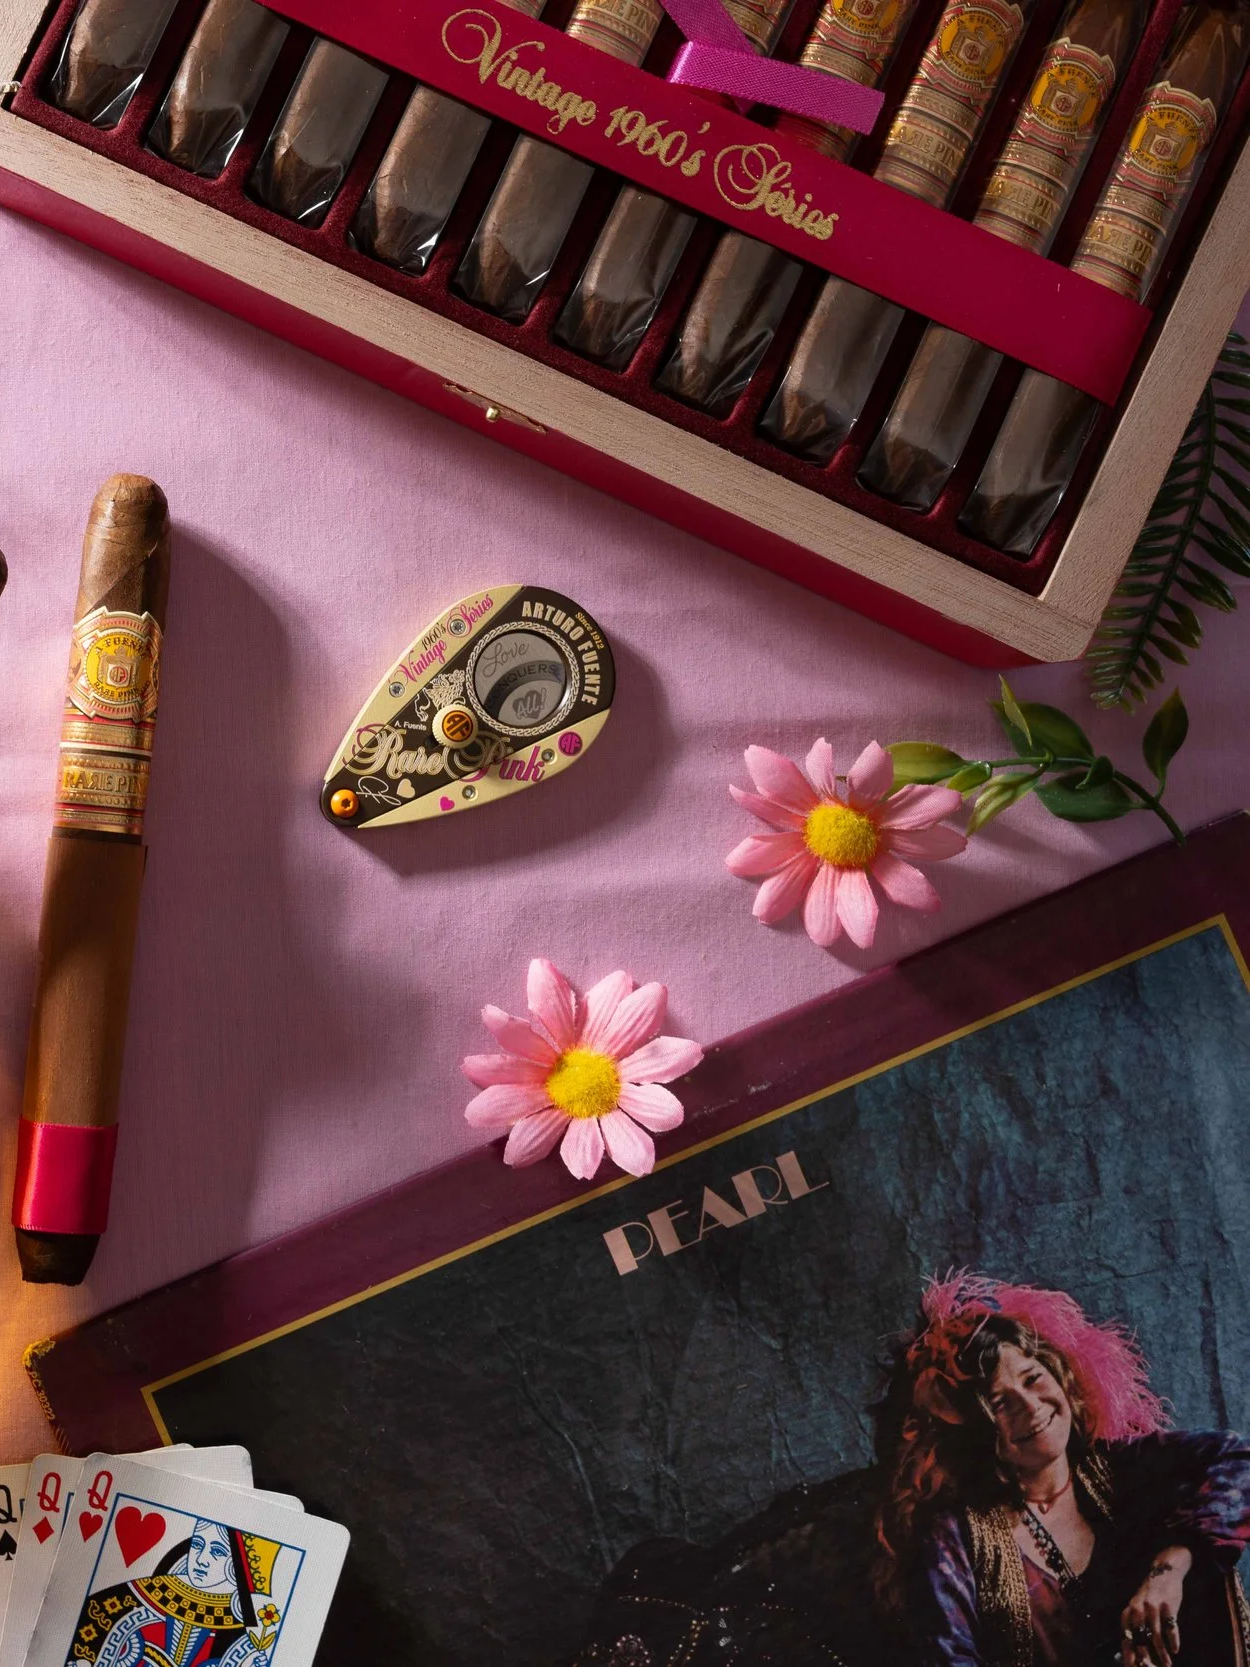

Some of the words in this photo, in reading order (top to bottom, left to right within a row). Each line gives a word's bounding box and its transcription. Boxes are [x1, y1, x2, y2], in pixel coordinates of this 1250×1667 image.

[442, 9, 596, 135] Vintage
[604, 106, 710, 177] 1960's
[574, 611, 593, 633] Since
[590, 629, 605, 650] 1912
[388, 640, 447, 683] Vintage
[482, 642, 530, 678] Love
[521, 600, 585, 641] ARTURO
[577, 640, 601, 706] FUENTE
[403, 720, 427, 731] Fuente
[342, 723, 445, 780] Rare
[603, 1151, 829, 1276] PEARL
[37, 1471, 61, 1513] Q
[87, 1470, 113, 1512] Q
